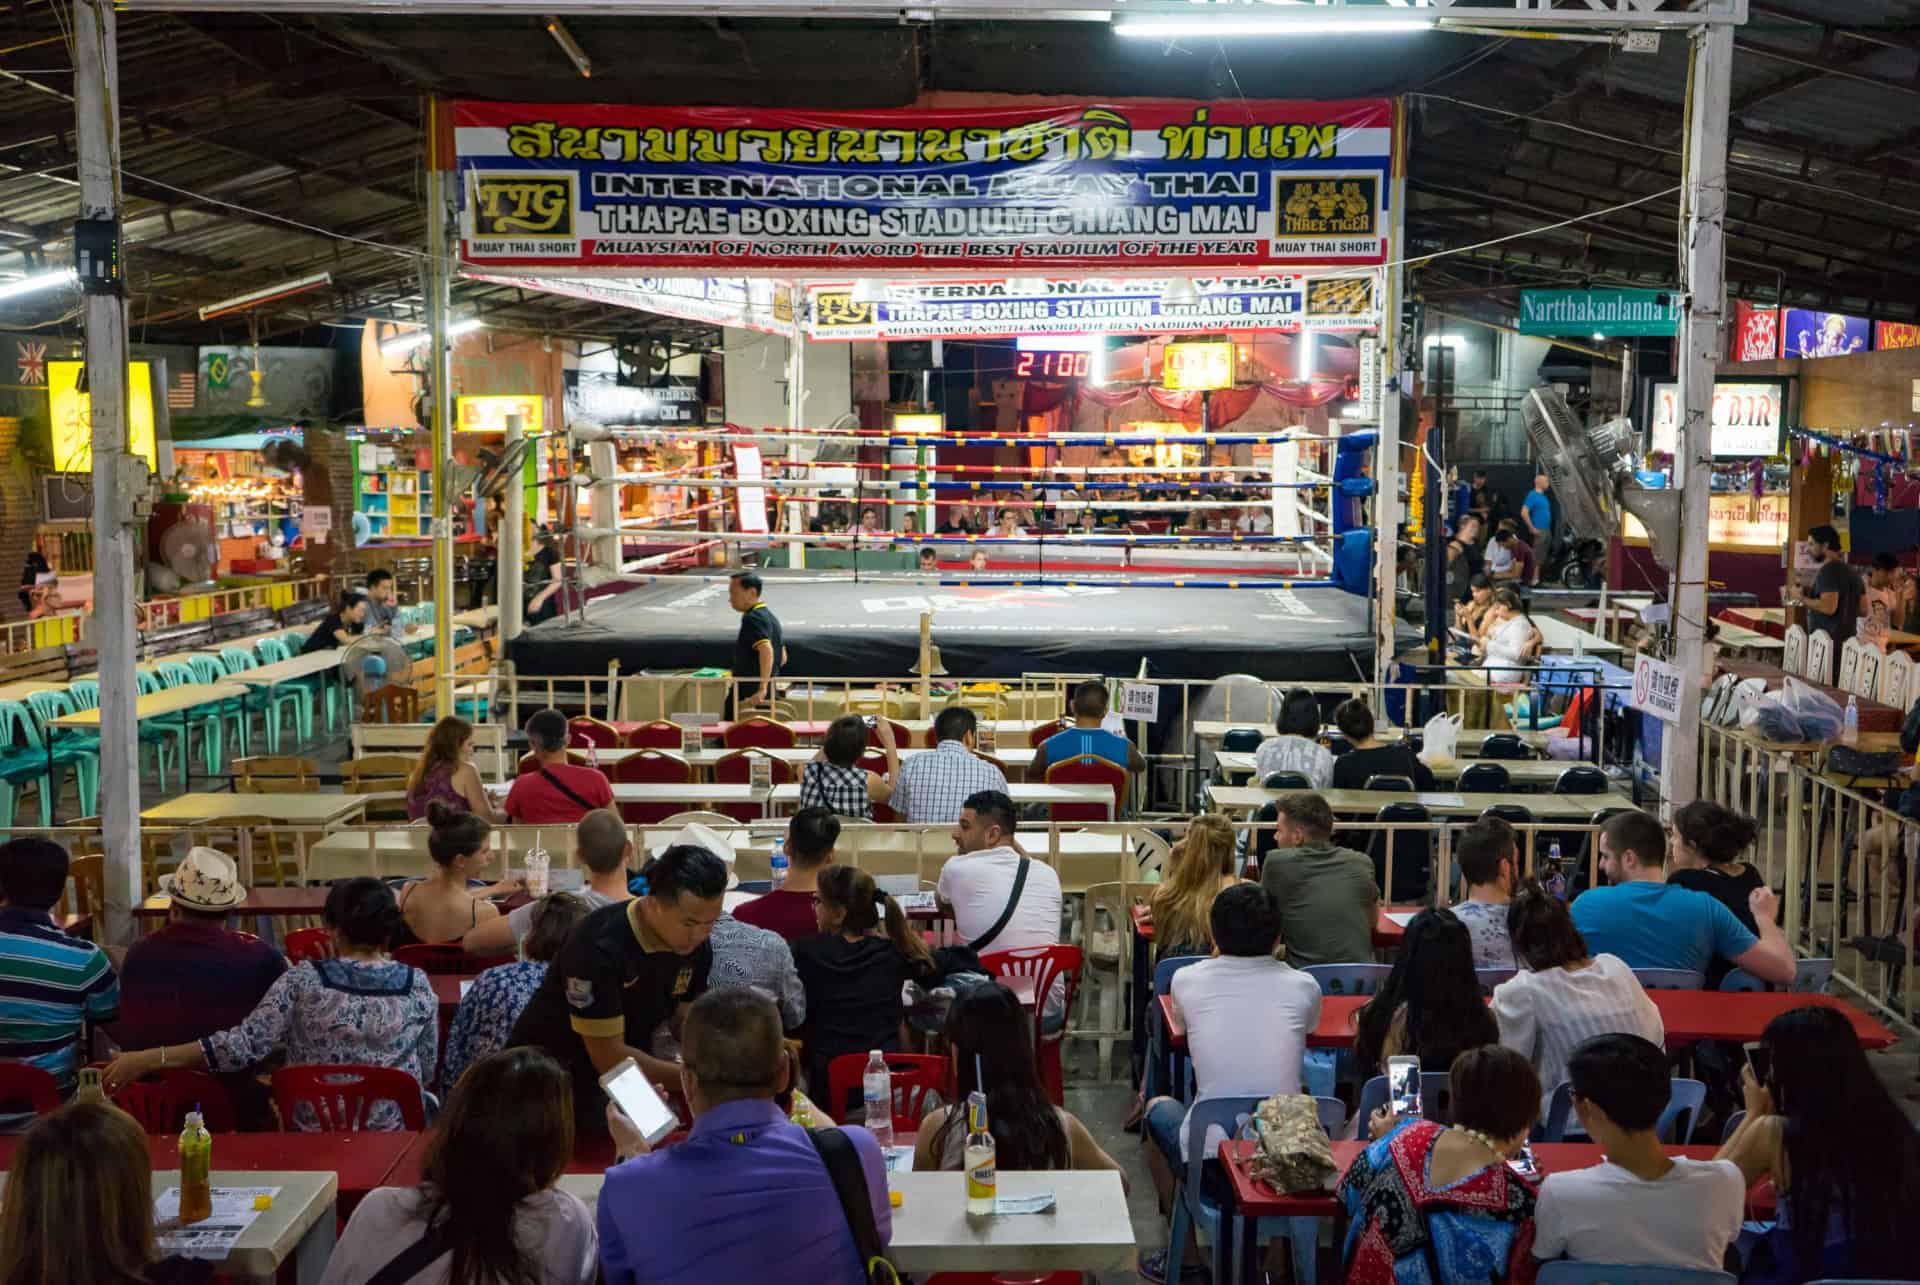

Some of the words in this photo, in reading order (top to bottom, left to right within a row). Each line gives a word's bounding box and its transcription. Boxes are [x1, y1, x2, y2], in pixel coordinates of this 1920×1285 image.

[1159, 107, 1342, 161] ท่าแพ
[592, 173, 979, 200] INTERNATIONAL
[1147, 171, 1259, 197] THAI
[594, 203, 730, 235] THAPAE
[739, 205, 871, 237] BOXING
[878, 205, 1038, 237] STADIUM
[1046, 204, 1179, 236] CHIANG
[1190, 203, 1258, 234] MAI
[1284, 214, 1327, 233] THREE
[1332, 213, 1370, 232] TIGER
[472, 242, 506, 255] MUAY
[508, 242, 536, 254] THAI
[537, 242, 577, 254] SHORT
[594, 240, 716, 256] MUAYSIAM
[717, 241, 748, 256] OF
[751, 241, 829, 256] NORTH
[831, 241, 916, 257] AWORD
[922, 241, 965, 257] THE
[967, 241, 1019, 257] BEST
[1022, 241, 1119, 257] STADIUM
[1123, 241, 1156, 257] OF
[1158, 241, 1199, 256] THE
[1201, 240, 1258, 256] YEAR
[1274, 243, 1307, 255] MUAY
[1310, 242, 1336, 254] THAI
[1338, 242, 1377, 254] SHORT
[970, 301, 1049, 321] BOXING
[1055, 298, 1152, 319] STADIUM
[1249, 295, 1293, 315] MAI
[1522, 293, 1663, 322] Nartthakanlanna
[463, 403, 536, 425] BR
